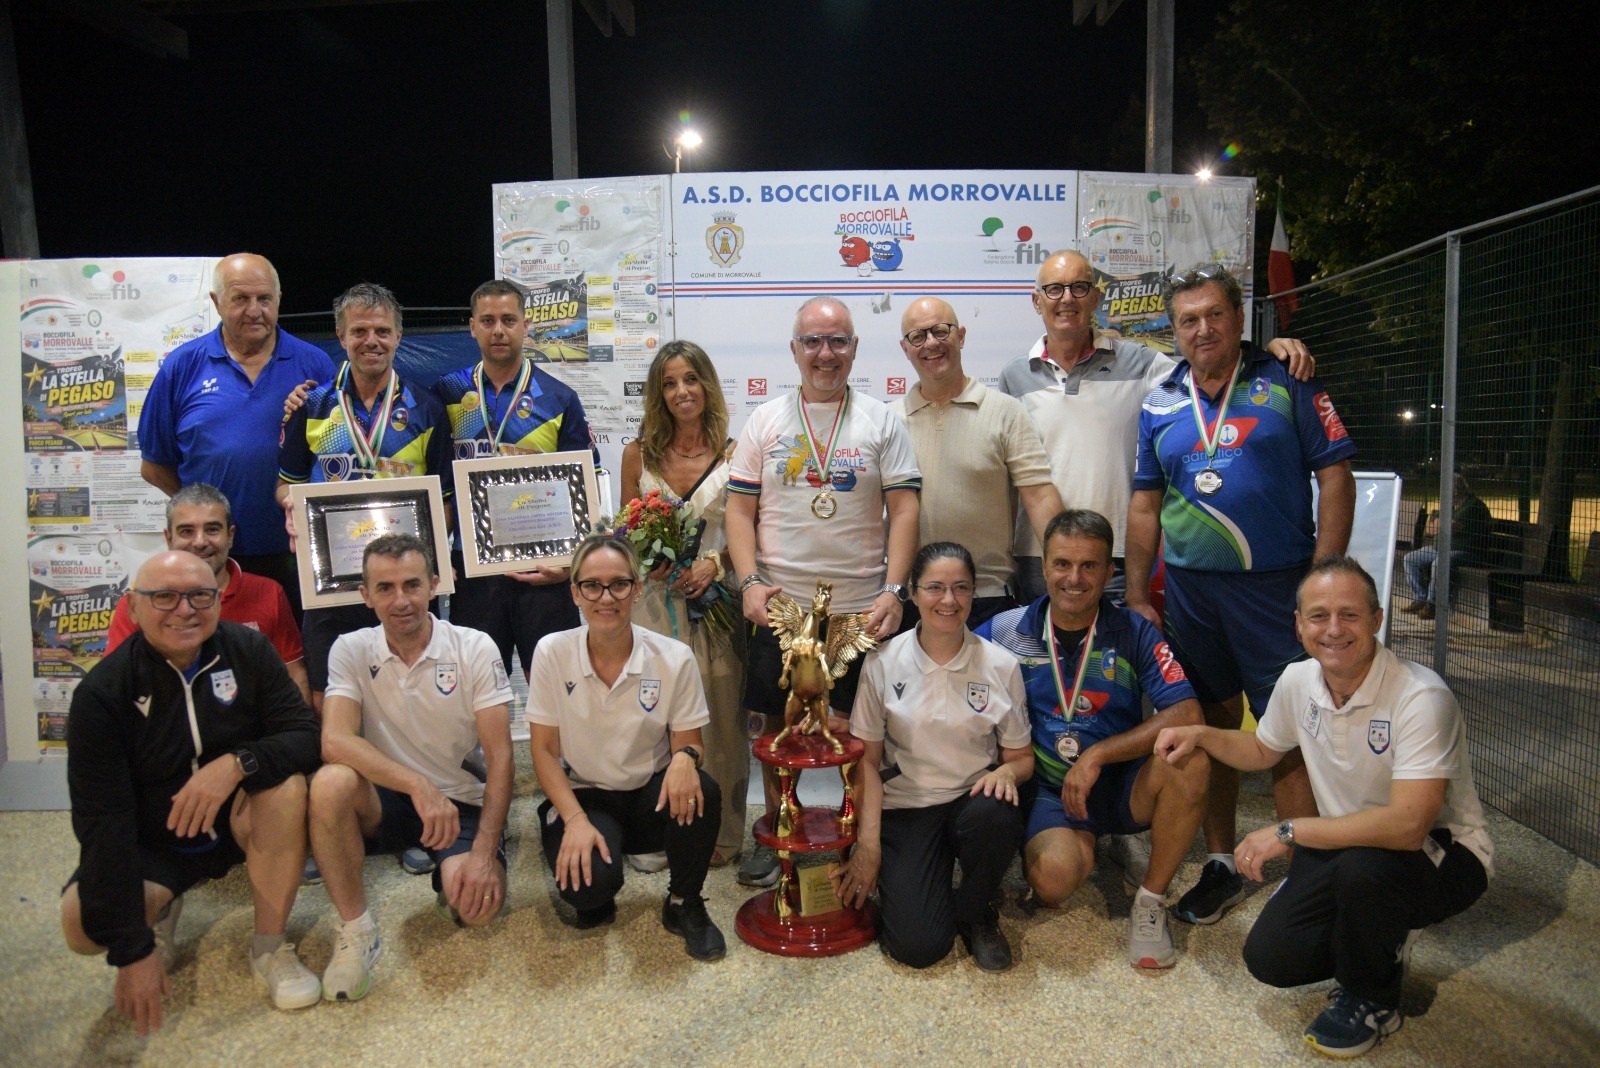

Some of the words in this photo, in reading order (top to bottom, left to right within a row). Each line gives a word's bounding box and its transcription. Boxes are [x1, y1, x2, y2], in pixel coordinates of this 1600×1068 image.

[682, 186, 751, 204] A.S.D.
[761, 184, 900, 203] BOCCIOFILA
[908, 183, 1066, 201] MORROVALLE
[840, 207, 909, 223] BOCCIOFILA
[578, 217, 600, 231] fib
[836, 221, 912, 237] MORROVALLE
[1014, 243, 1051, 264] fib
[1109, 255, 1154, 263] MORROVALLE
[111, 283, 141, 300] fib
[530, 287, 551, 295] TROFEO
[533, 291, 570, 306] STELLA
[1105, 287, 1119, 300] LA
[1122, 284, 1159, 298] STELLA
[524, 301, 578, 323] PEGASO
[43, 337, 93, 347] MORROVALLE
[42, 375, 58, 390] LA
[60, 368, 104, 387] STELLA
[47, 380, 115, 407] PEGASO
[1181, 447, 1243, 463] adritico
[51, 566, 102, 575] MORROVALLE
[65, 593, 89, 601] TROFEO
[51, 602, 67, 617] LA
[69, 597, 111, 615] STELLA
